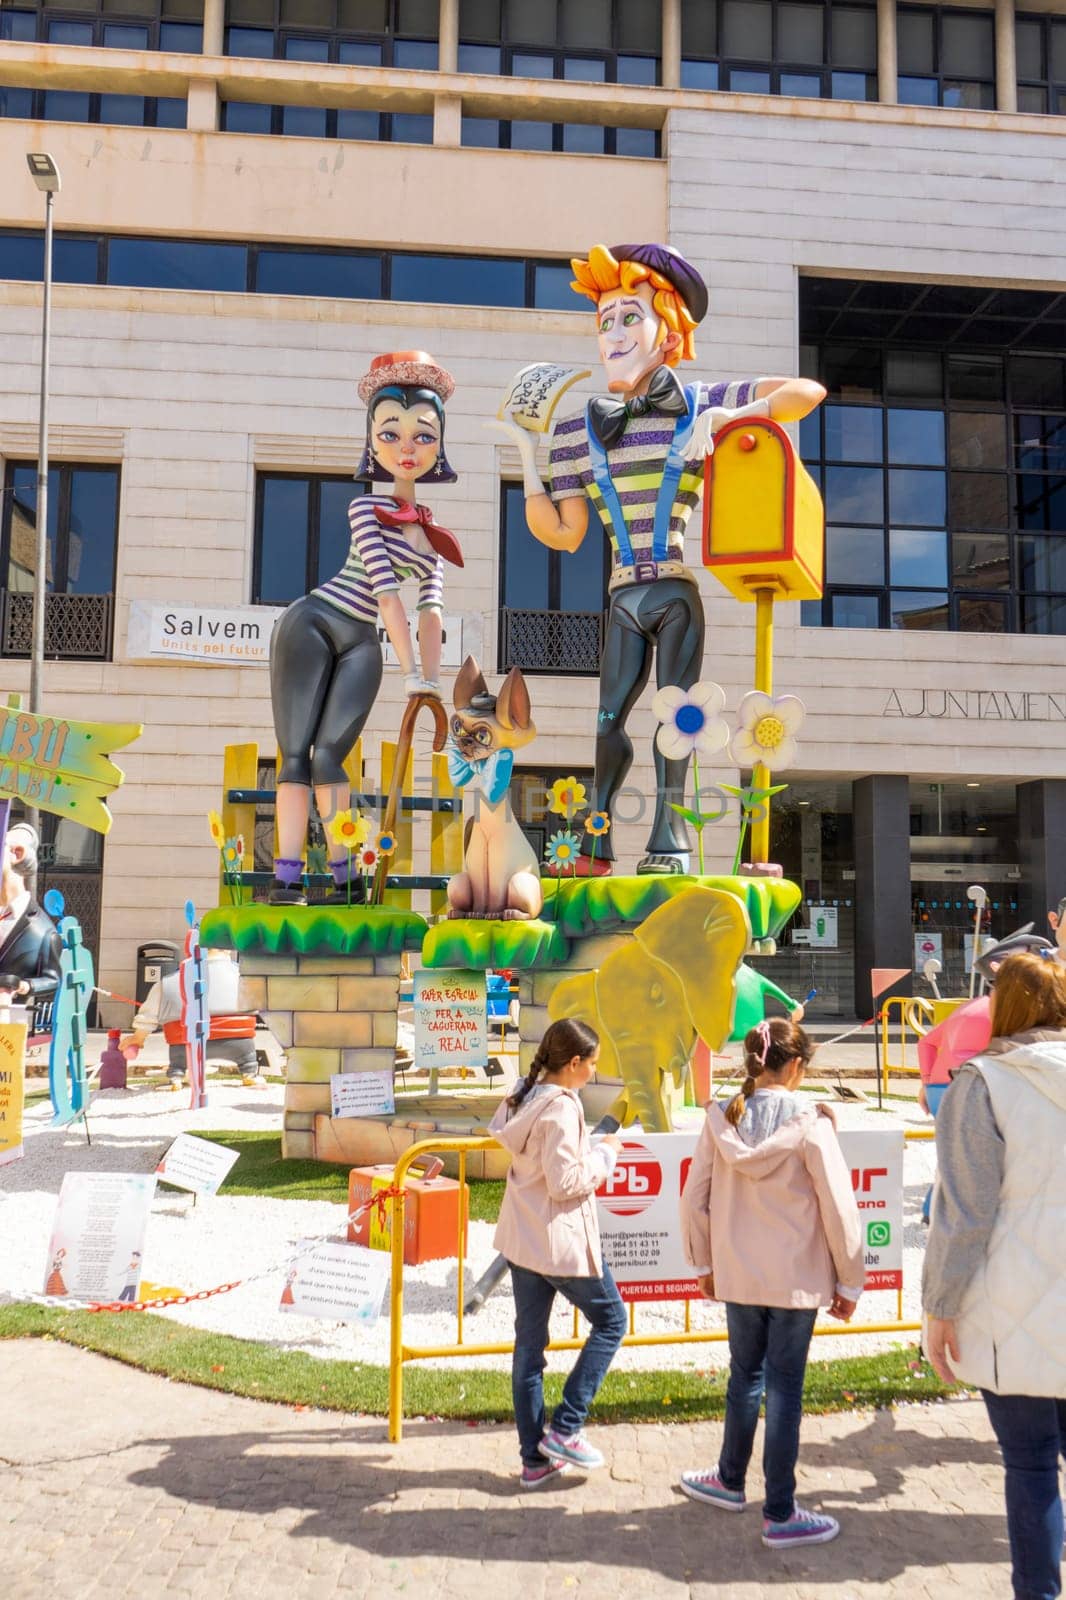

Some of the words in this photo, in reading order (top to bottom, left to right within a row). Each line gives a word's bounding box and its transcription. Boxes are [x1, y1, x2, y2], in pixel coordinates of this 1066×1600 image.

[162, 613, 260, 640] Salvem
[162, 638, 198, 652] Units
[203, 641, 225, 655] pel
[229, 643, 266, 656] futur
[421, 989, 443, 1003] PAPER
[445, 988, 477, 1001] ESPECIAL
[435, 1009, 452, 1021] PER
[455, 1009, 463, 1019] A
[428, 1021, 478, 1035] CAGUERADA
[438, 1037, 469, 1052] REAL
[620, 1285, 653, 1295] PUERTAS
[655, 1284, 665, 1293] DE
